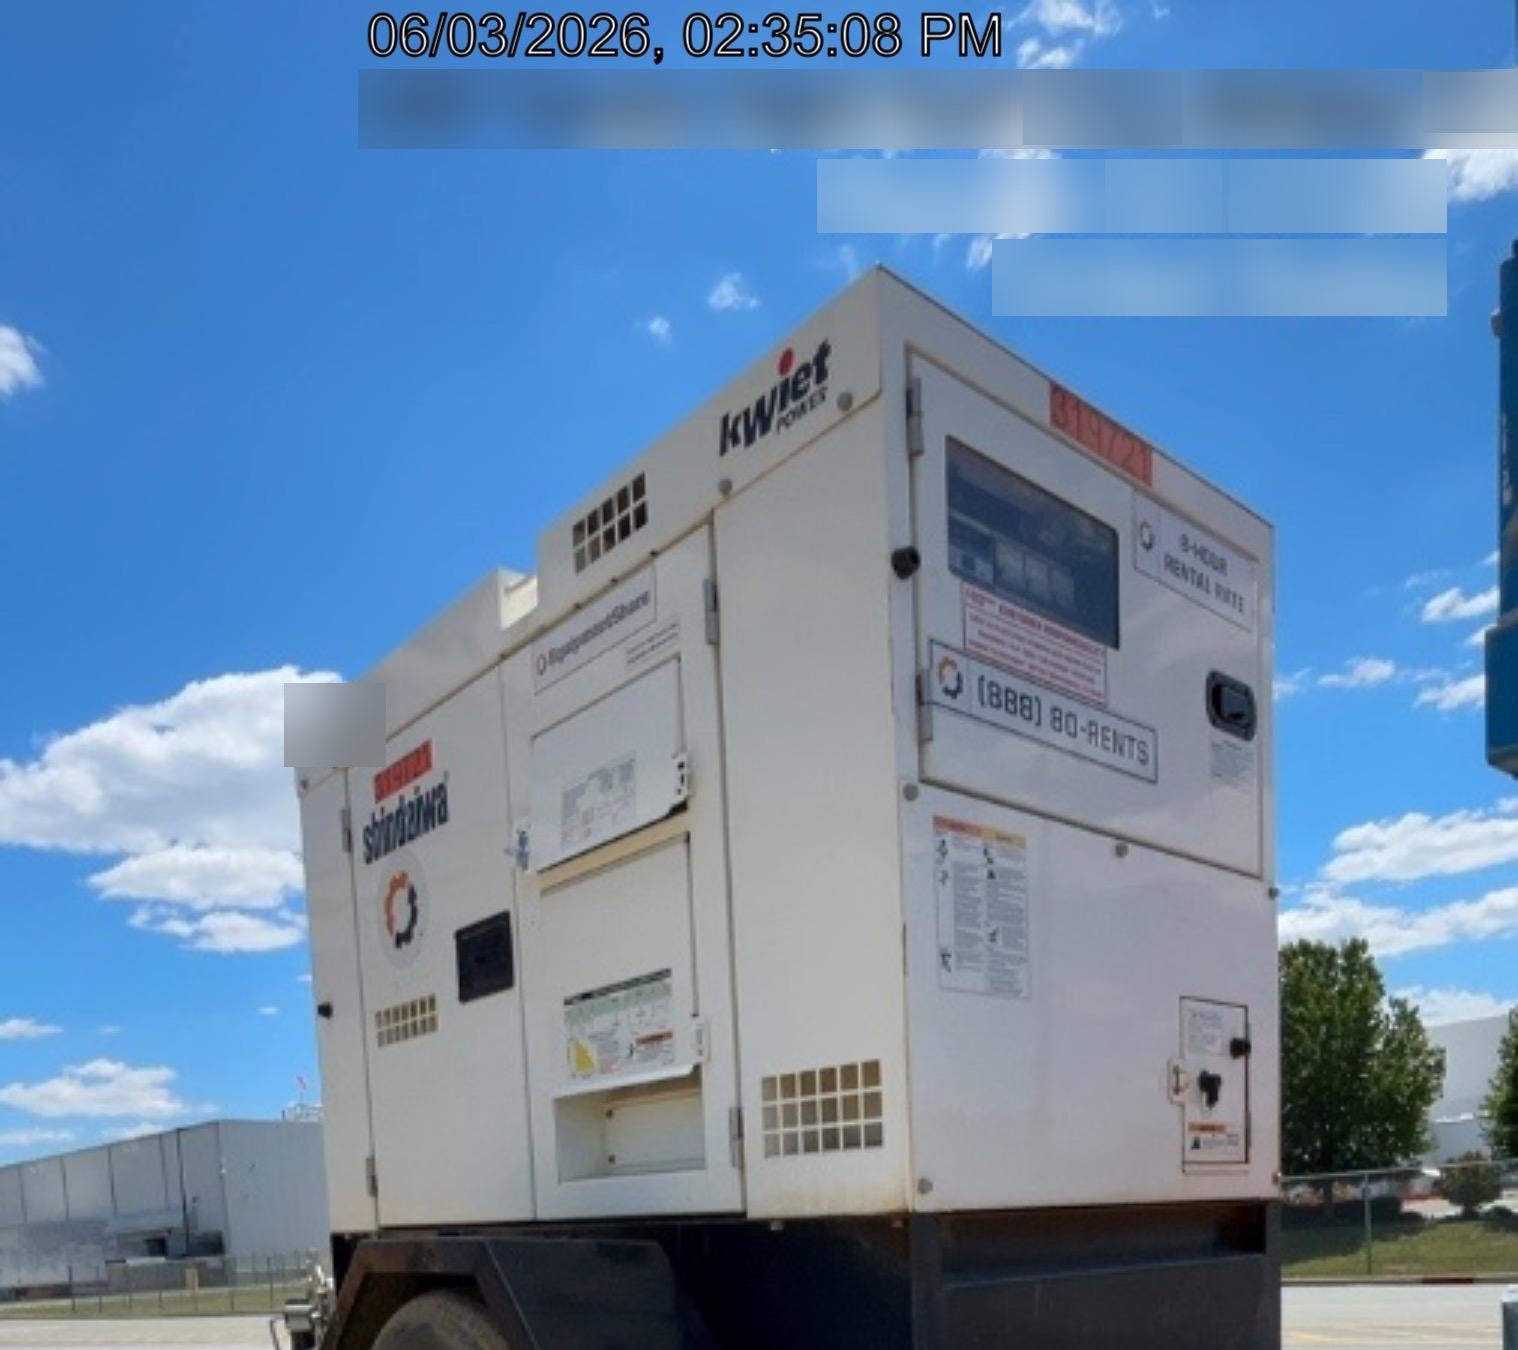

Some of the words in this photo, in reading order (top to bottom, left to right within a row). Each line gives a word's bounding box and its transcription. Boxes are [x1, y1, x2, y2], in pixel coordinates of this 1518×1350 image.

[1163, 553, 1211, 598] RENTAL
[1214, 582, 1245, 614] RATE
[977, 674, 1042, 728] (888)
[1050, 705, 1150, 766] 80-RENTS
